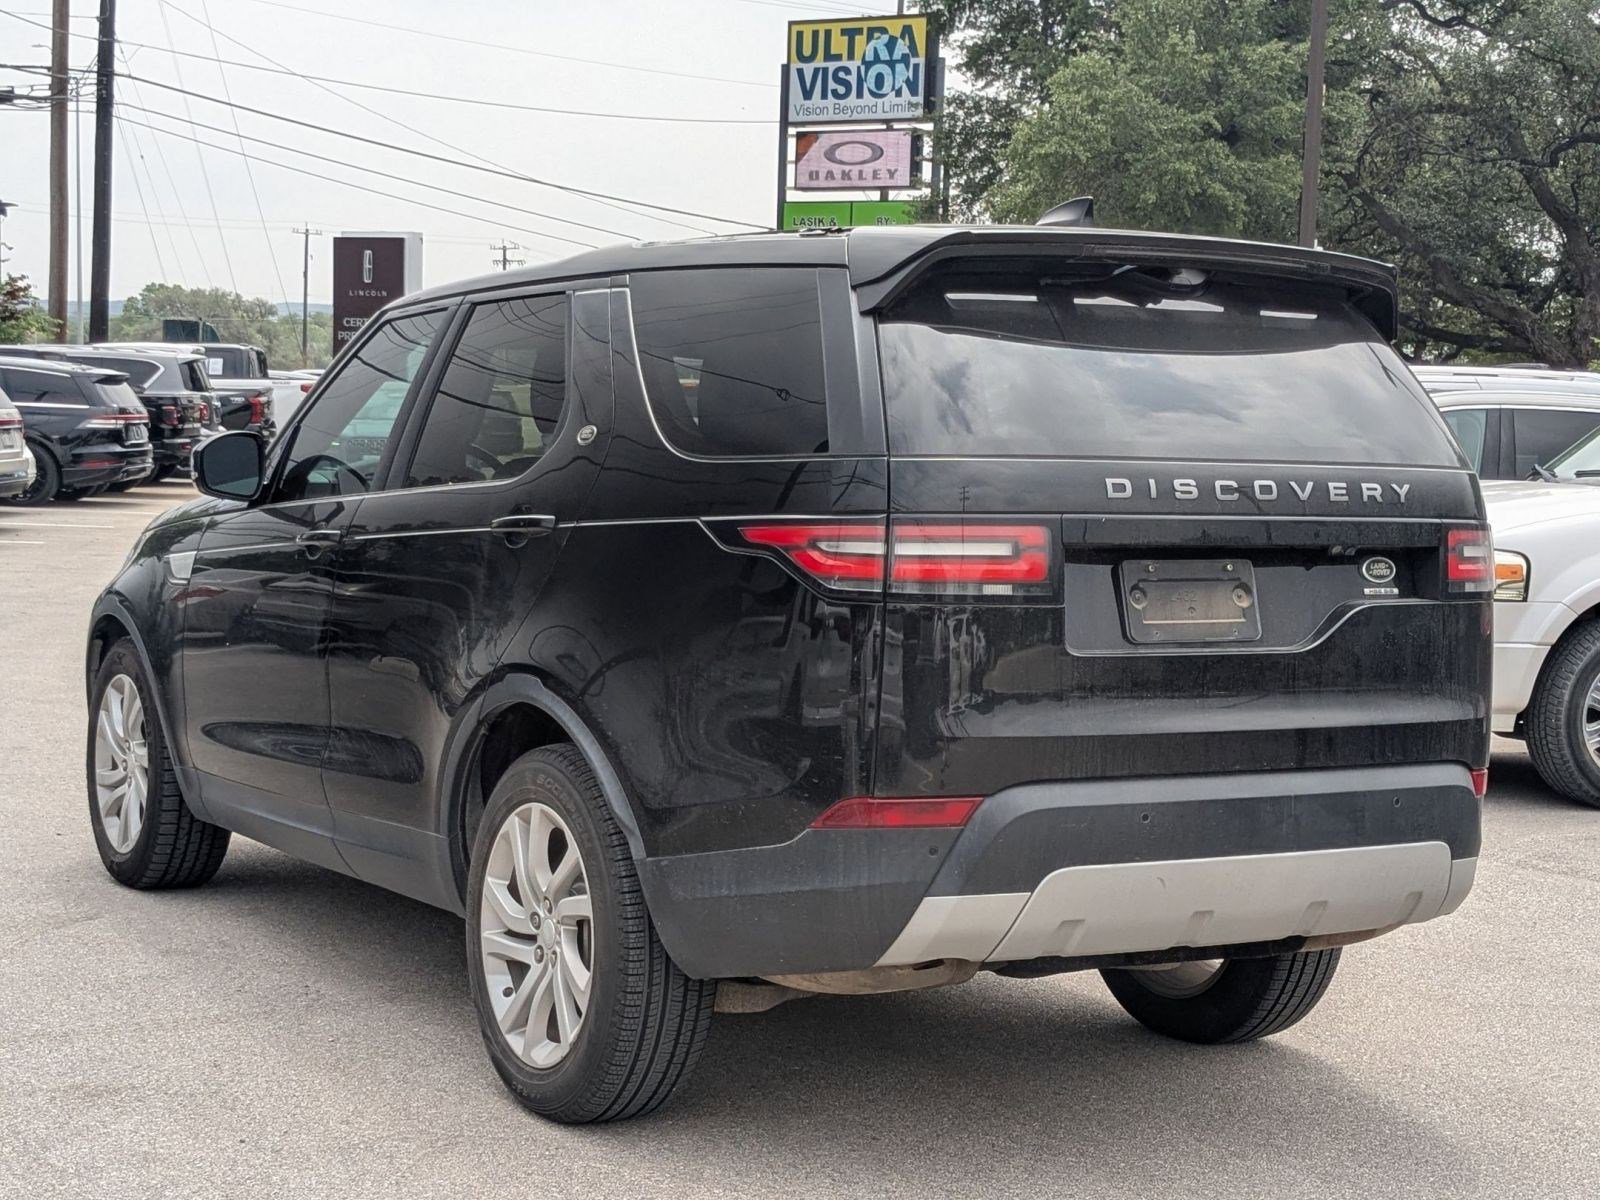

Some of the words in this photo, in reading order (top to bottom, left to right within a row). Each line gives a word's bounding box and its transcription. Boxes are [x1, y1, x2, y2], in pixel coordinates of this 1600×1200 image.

[795, 24, 920, 64] ULTRA
[796, 63, 920, 101] VISION
[794, 103, 829, 117] Vision
[832, 101, 878, 118] Beyond
[882, 100, 918, 114] Limits
[808, 168, 898, 181] OAKLEY
[792, 217, 825, 227] LASIK
[829, 217, 837, 227] &
[1105, 477, 1411, 503] DISCOVERY
